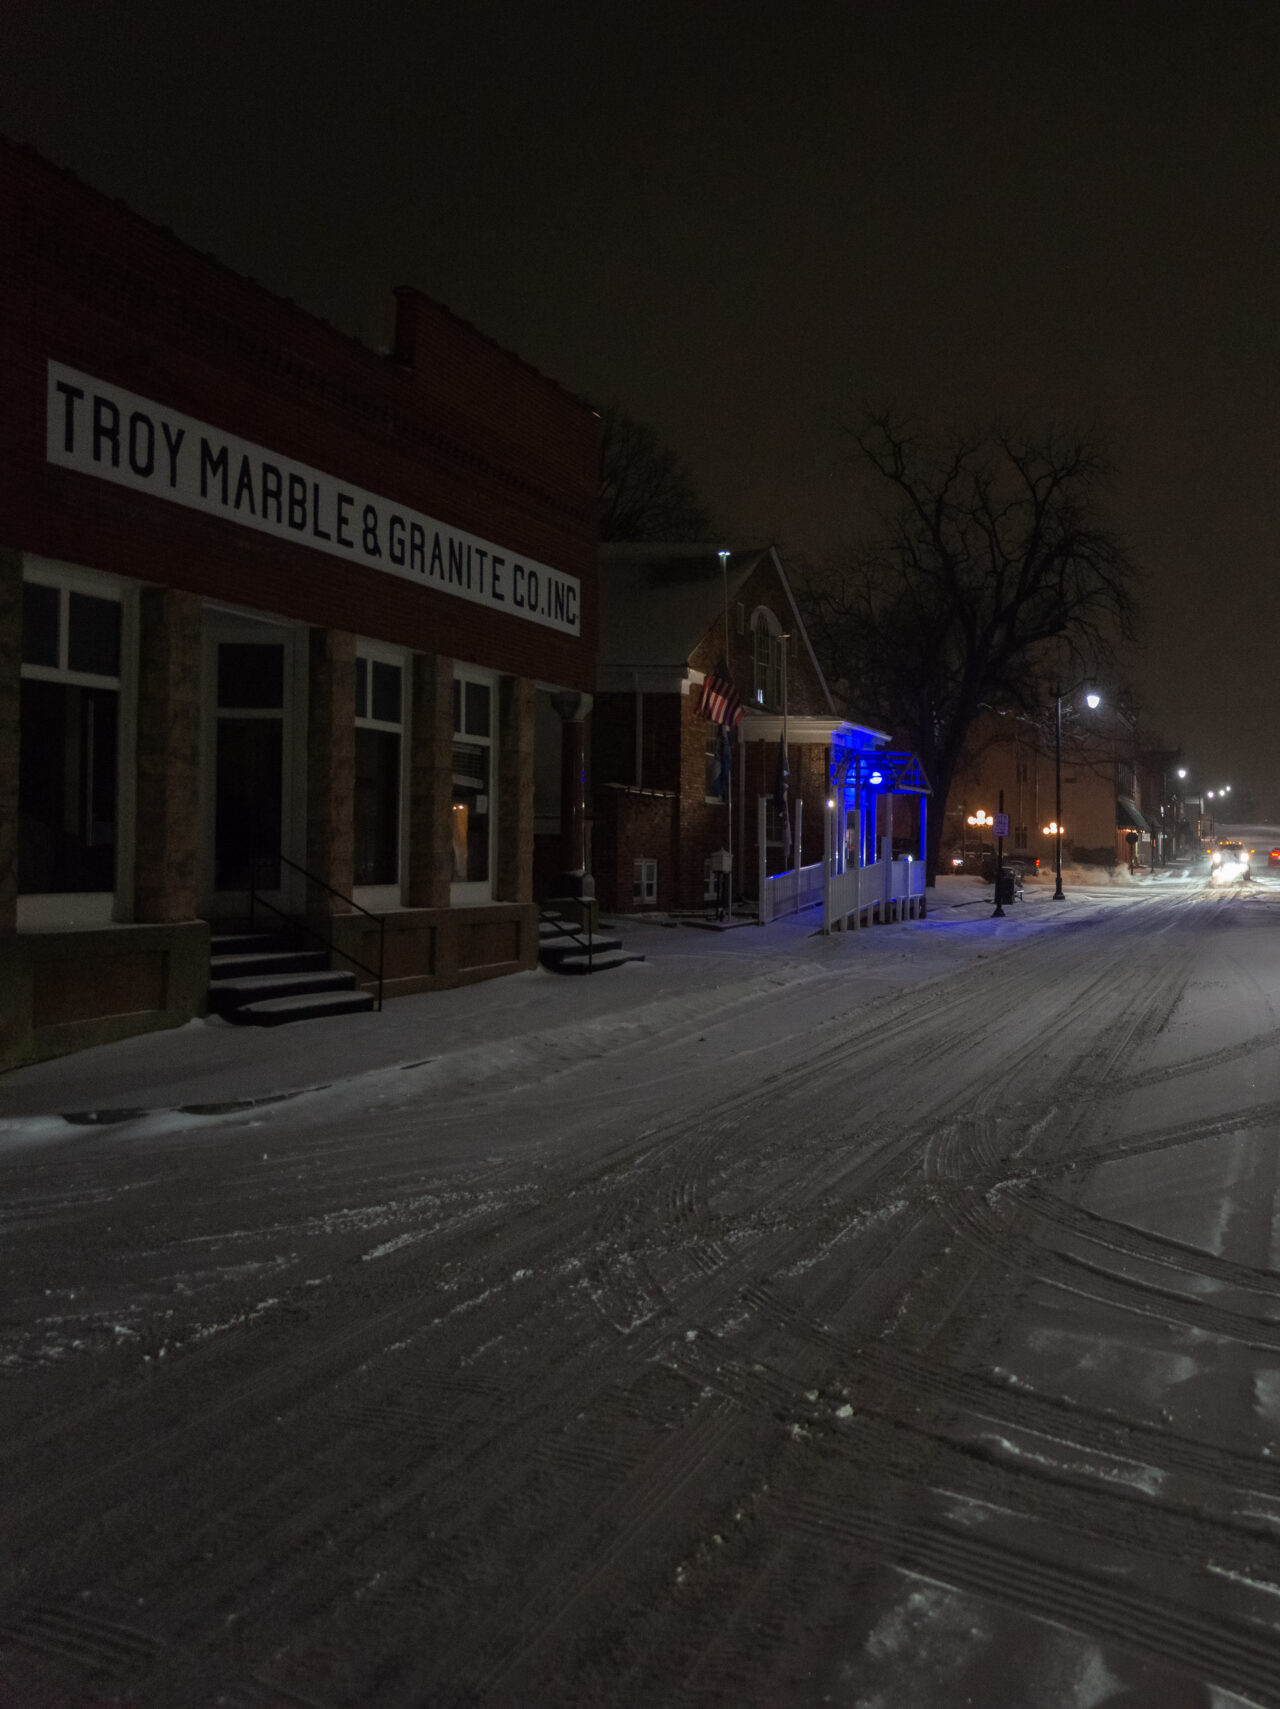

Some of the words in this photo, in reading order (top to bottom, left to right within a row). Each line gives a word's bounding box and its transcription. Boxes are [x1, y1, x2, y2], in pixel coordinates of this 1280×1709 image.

[57, 380, 185, 488] TROY
[200, 438, 354, 549] MARBLE
[362, 503, 382, 558] &
[389, 503, 505, 601] GRANITE
